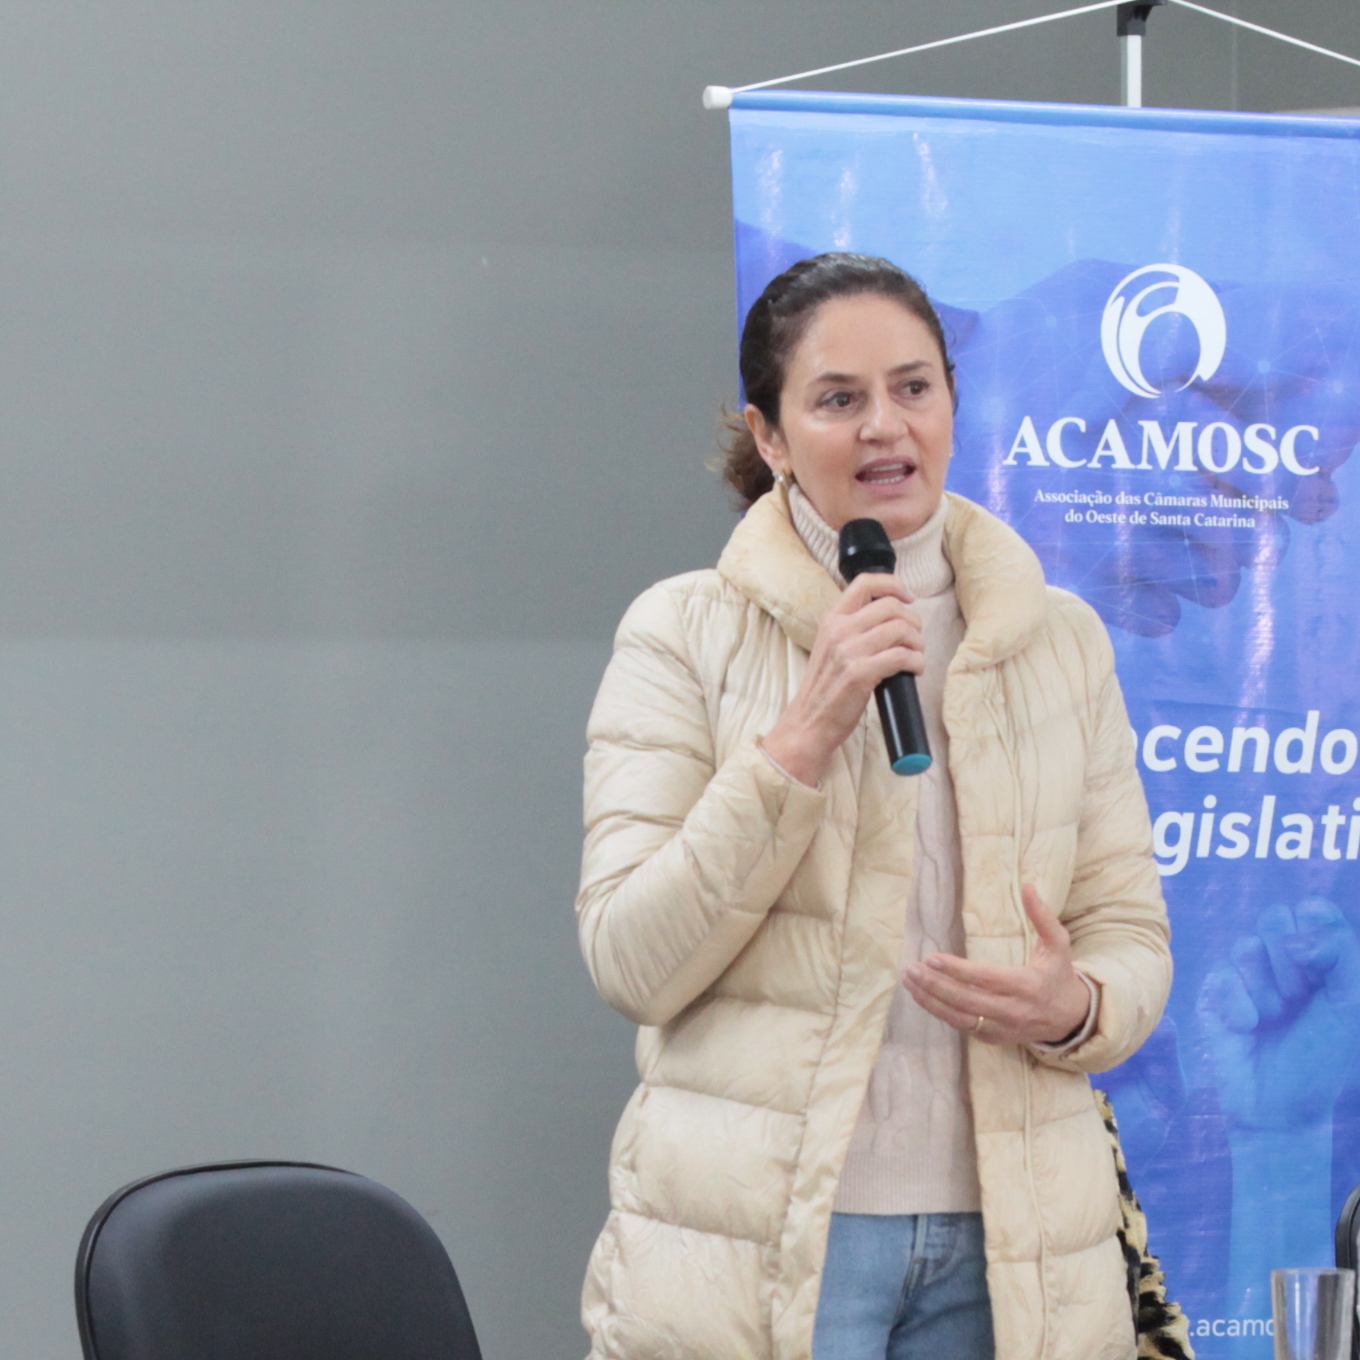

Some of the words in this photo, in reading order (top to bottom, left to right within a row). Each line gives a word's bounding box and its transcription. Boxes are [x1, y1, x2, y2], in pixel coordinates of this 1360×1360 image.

[1002, 415, 1321, 476] ACAMOSC
[1034, 488, 1113, 507] Associação
[1115, 490, 1141, 506] das
[1144, 492, 1208, 508] Câmaras
[1210, 493, 1290, 512] Municipais
[1065, 509, 1083, 523] do
[1086, 509, 1127, 525] Oeste
[1129, 511, 1147, 525] de
[1150, 511, 1192, 526] Santa
[1194, 513, 1257, 529] Catarina
[1131, 710, 1359, 776] cendo
